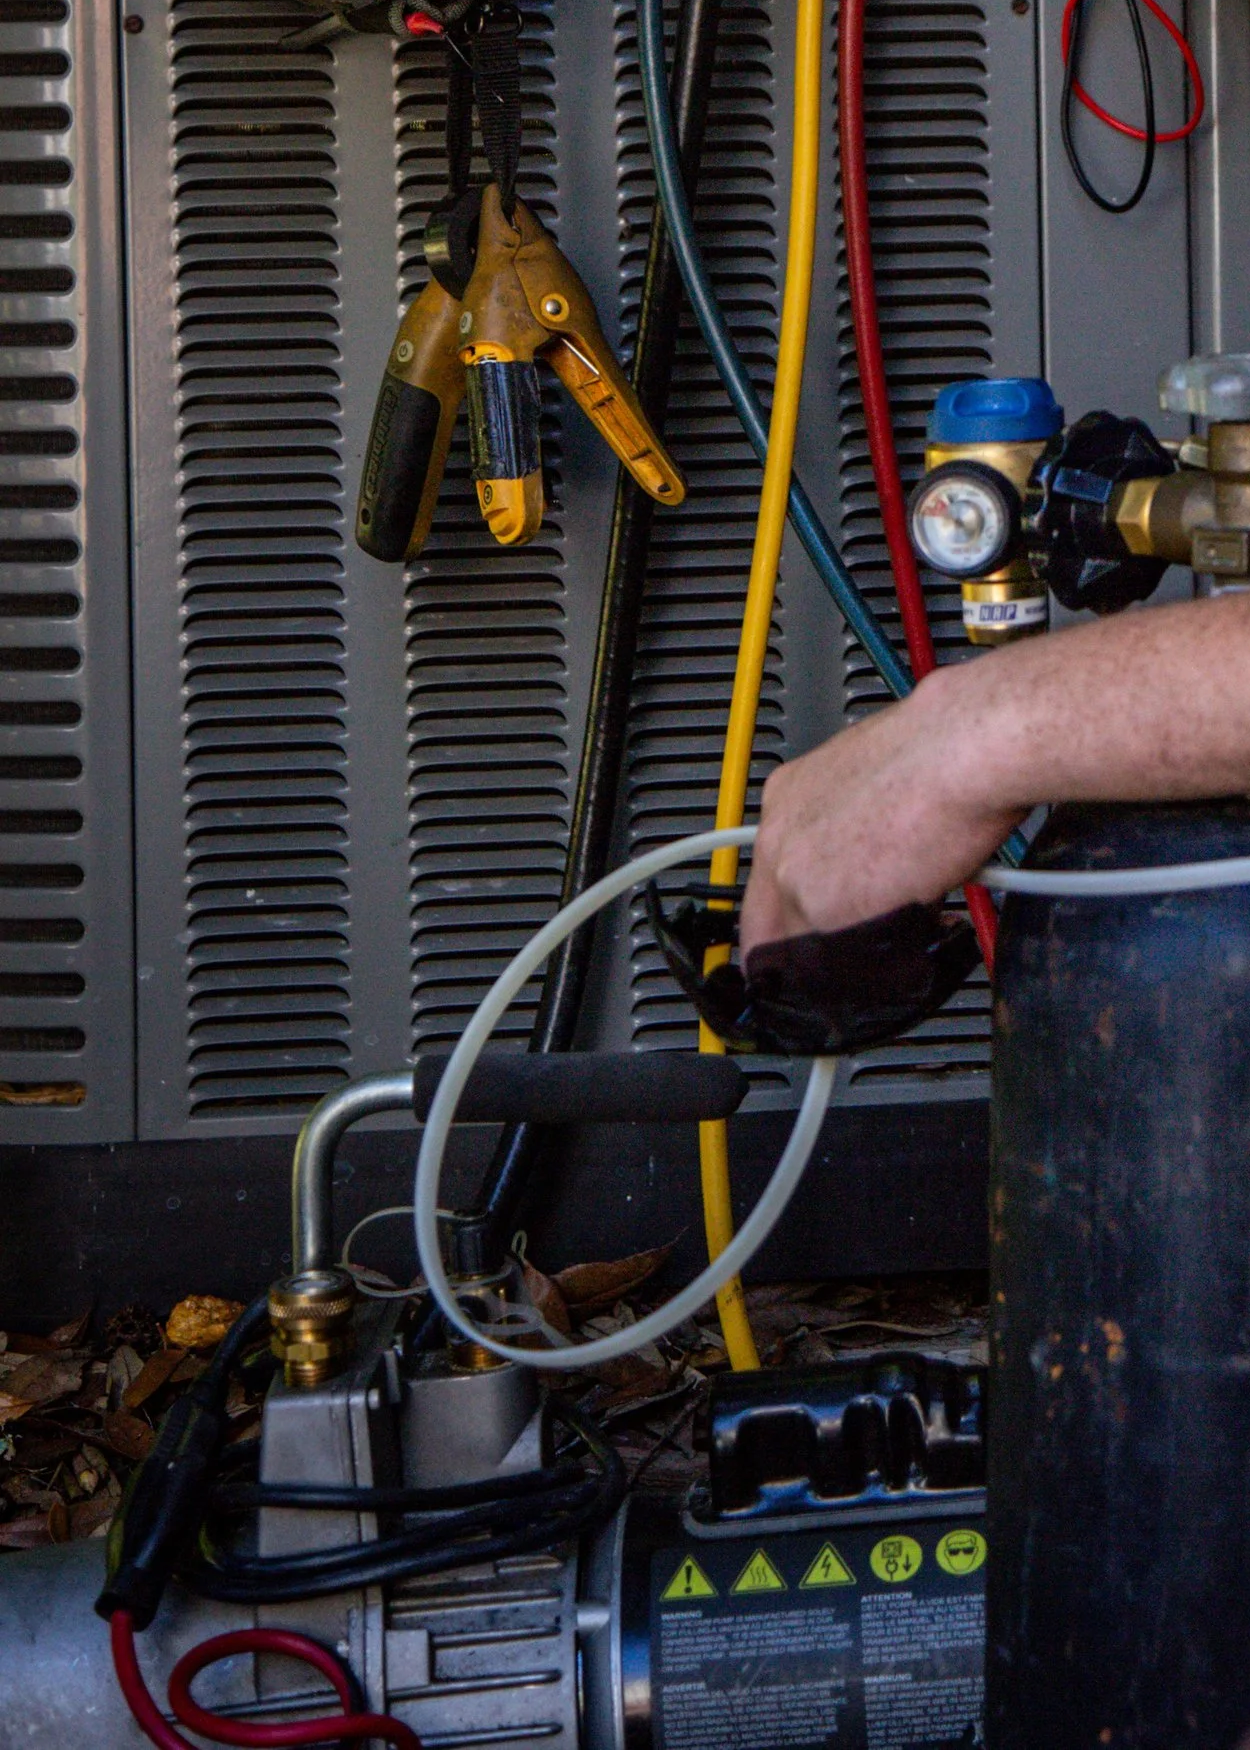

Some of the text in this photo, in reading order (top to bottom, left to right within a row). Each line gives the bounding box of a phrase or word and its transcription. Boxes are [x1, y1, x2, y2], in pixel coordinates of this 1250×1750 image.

[861, 1593, 912, 1602] ATTENTION
[661, 1611, 702, 1621] WARNING
[864, 1674, 912, 1684] WARNUNG
